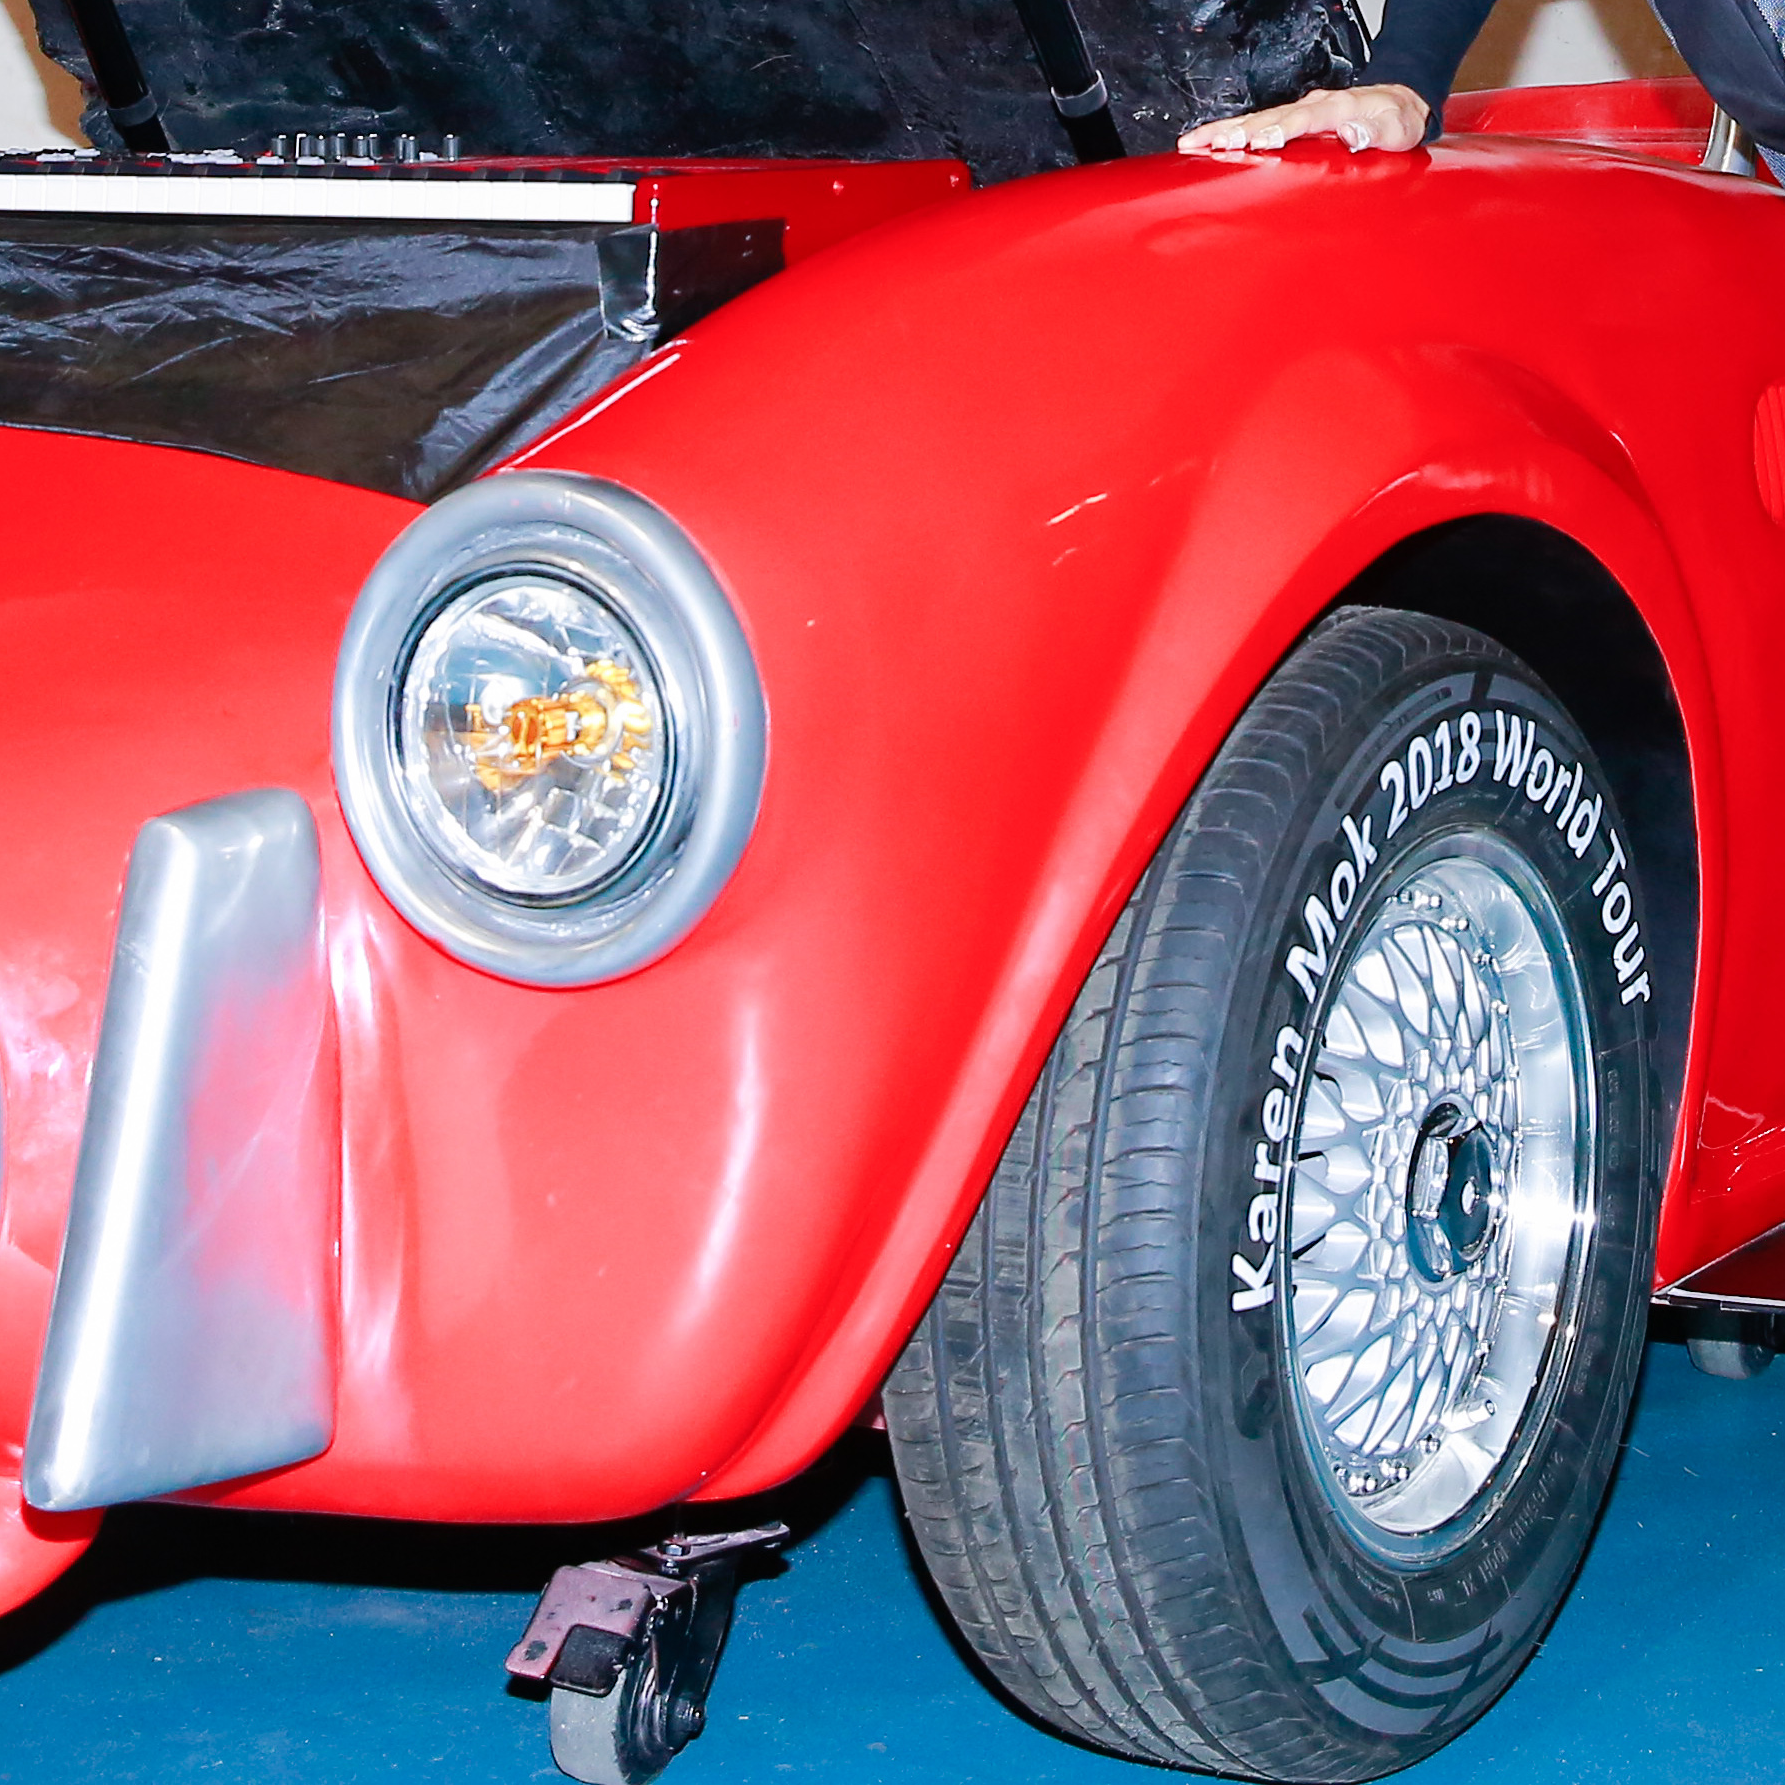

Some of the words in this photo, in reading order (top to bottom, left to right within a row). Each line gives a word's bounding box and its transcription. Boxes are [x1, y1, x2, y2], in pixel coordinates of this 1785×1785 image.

[1229, 1023, 1305, 1313] Karen
[1285, 813, 1380, 1004] Mok
[1379, 710, 1482, 840] 2018
[1492, 709, 1604, 859] World
[1590, 828, 1653, 1006] Tour
